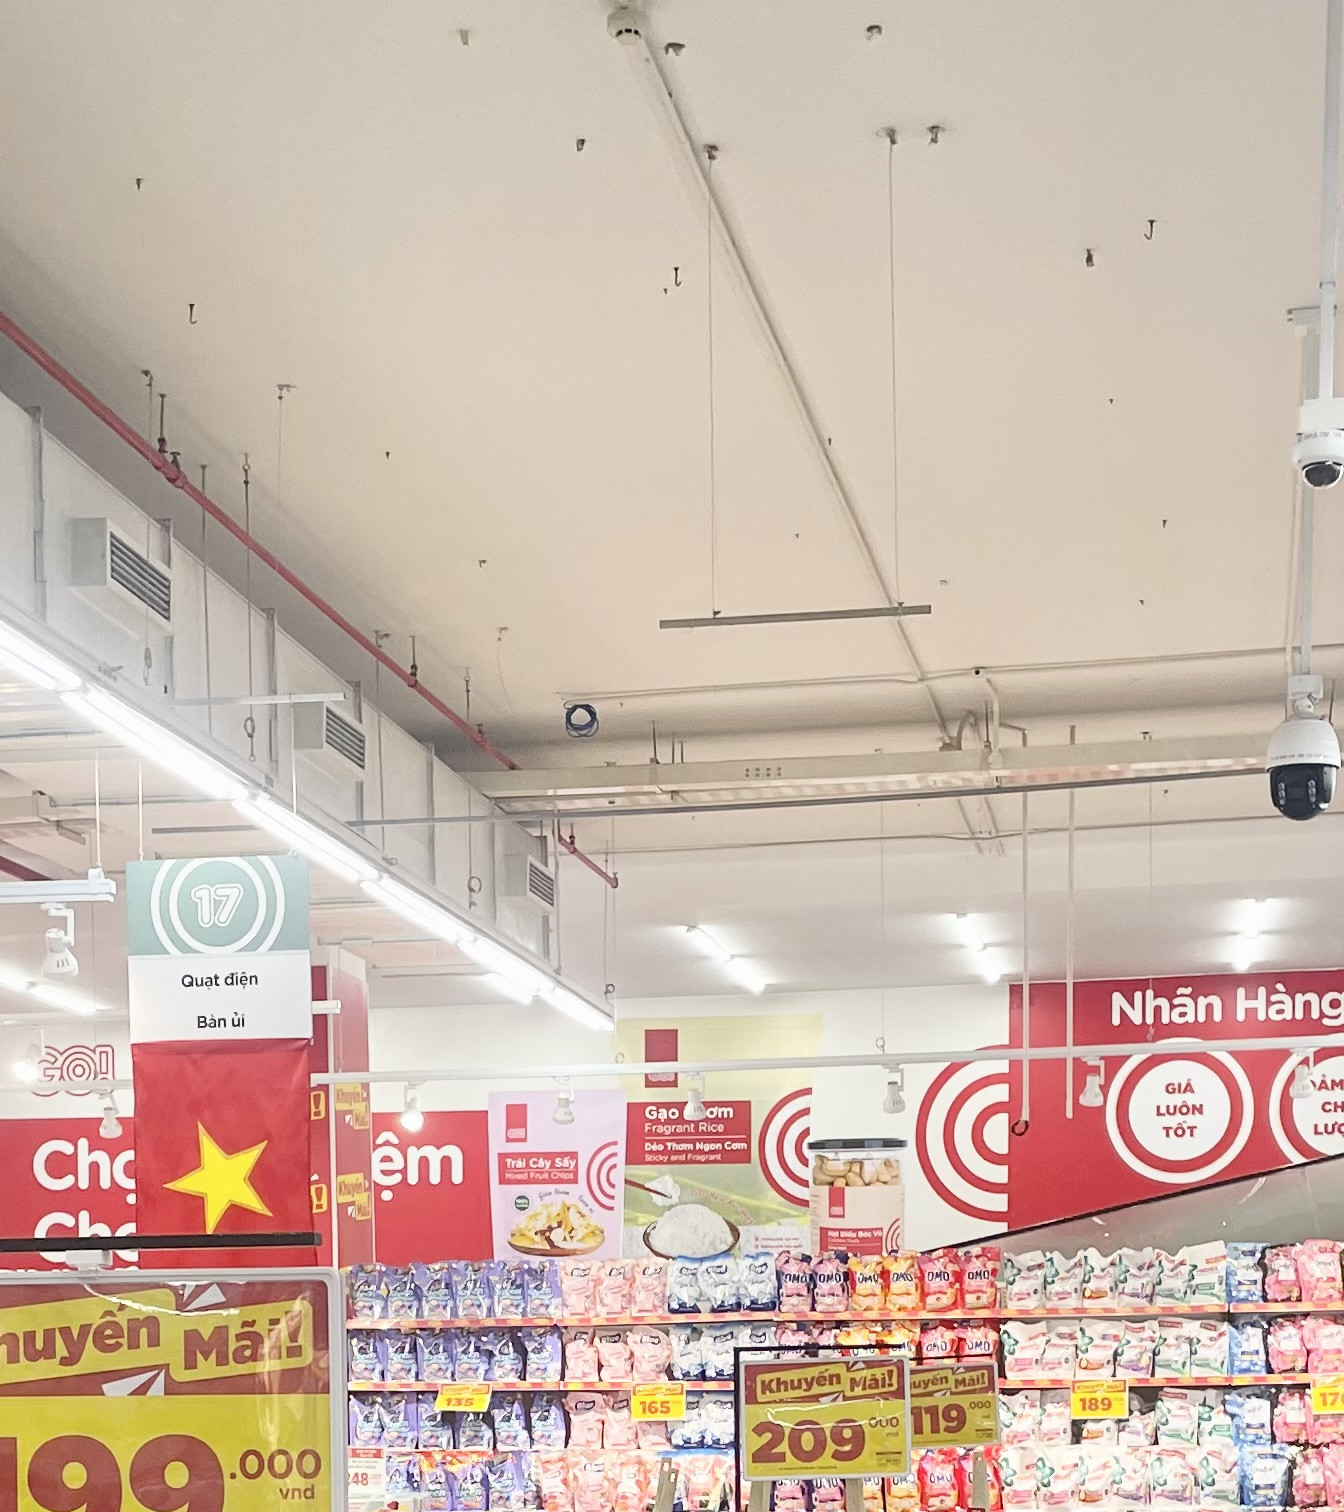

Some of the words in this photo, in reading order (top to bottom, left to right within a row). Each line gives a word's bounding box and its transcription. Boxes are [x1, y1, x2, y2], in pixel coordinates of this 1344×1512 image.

[190, 883, 244, 928] 17
[181, 971, 220, 993] Quạt
[223, 969, 259, 991] điện
[1110, 985, 1223, 1027] Nhãn
[196, 1012, 226, 1031] Bàn
[229, 1010, 246, 1031] ủi
[1164, 1076, 1196, 1095] GIÁ
[644, 1104, 677, 1124] Gạo
[1155, 1099, 1204, 1118] LUÔN
[644, 1122, 695, 1135] Fragrant
[698, 1121, 725, 1134] Rice
[1162, 1118, 1197, 1140] TỐT
[182, 1309, 304, 1371] Mãi!
[759, 1368, 842, 1396] Khuyến
[849, 1369, 895, 1392] Mãi!
[955, 1370, 987, 1389] Mãi!
[639, 1400, 673, 1417] 165
[1079, 1396, 1113, 1412] 189
[911, 1403, 967, 1434] 119
[750, 1418, 866, 1465] 209
[278, 1484, 317, 1502] vnd
